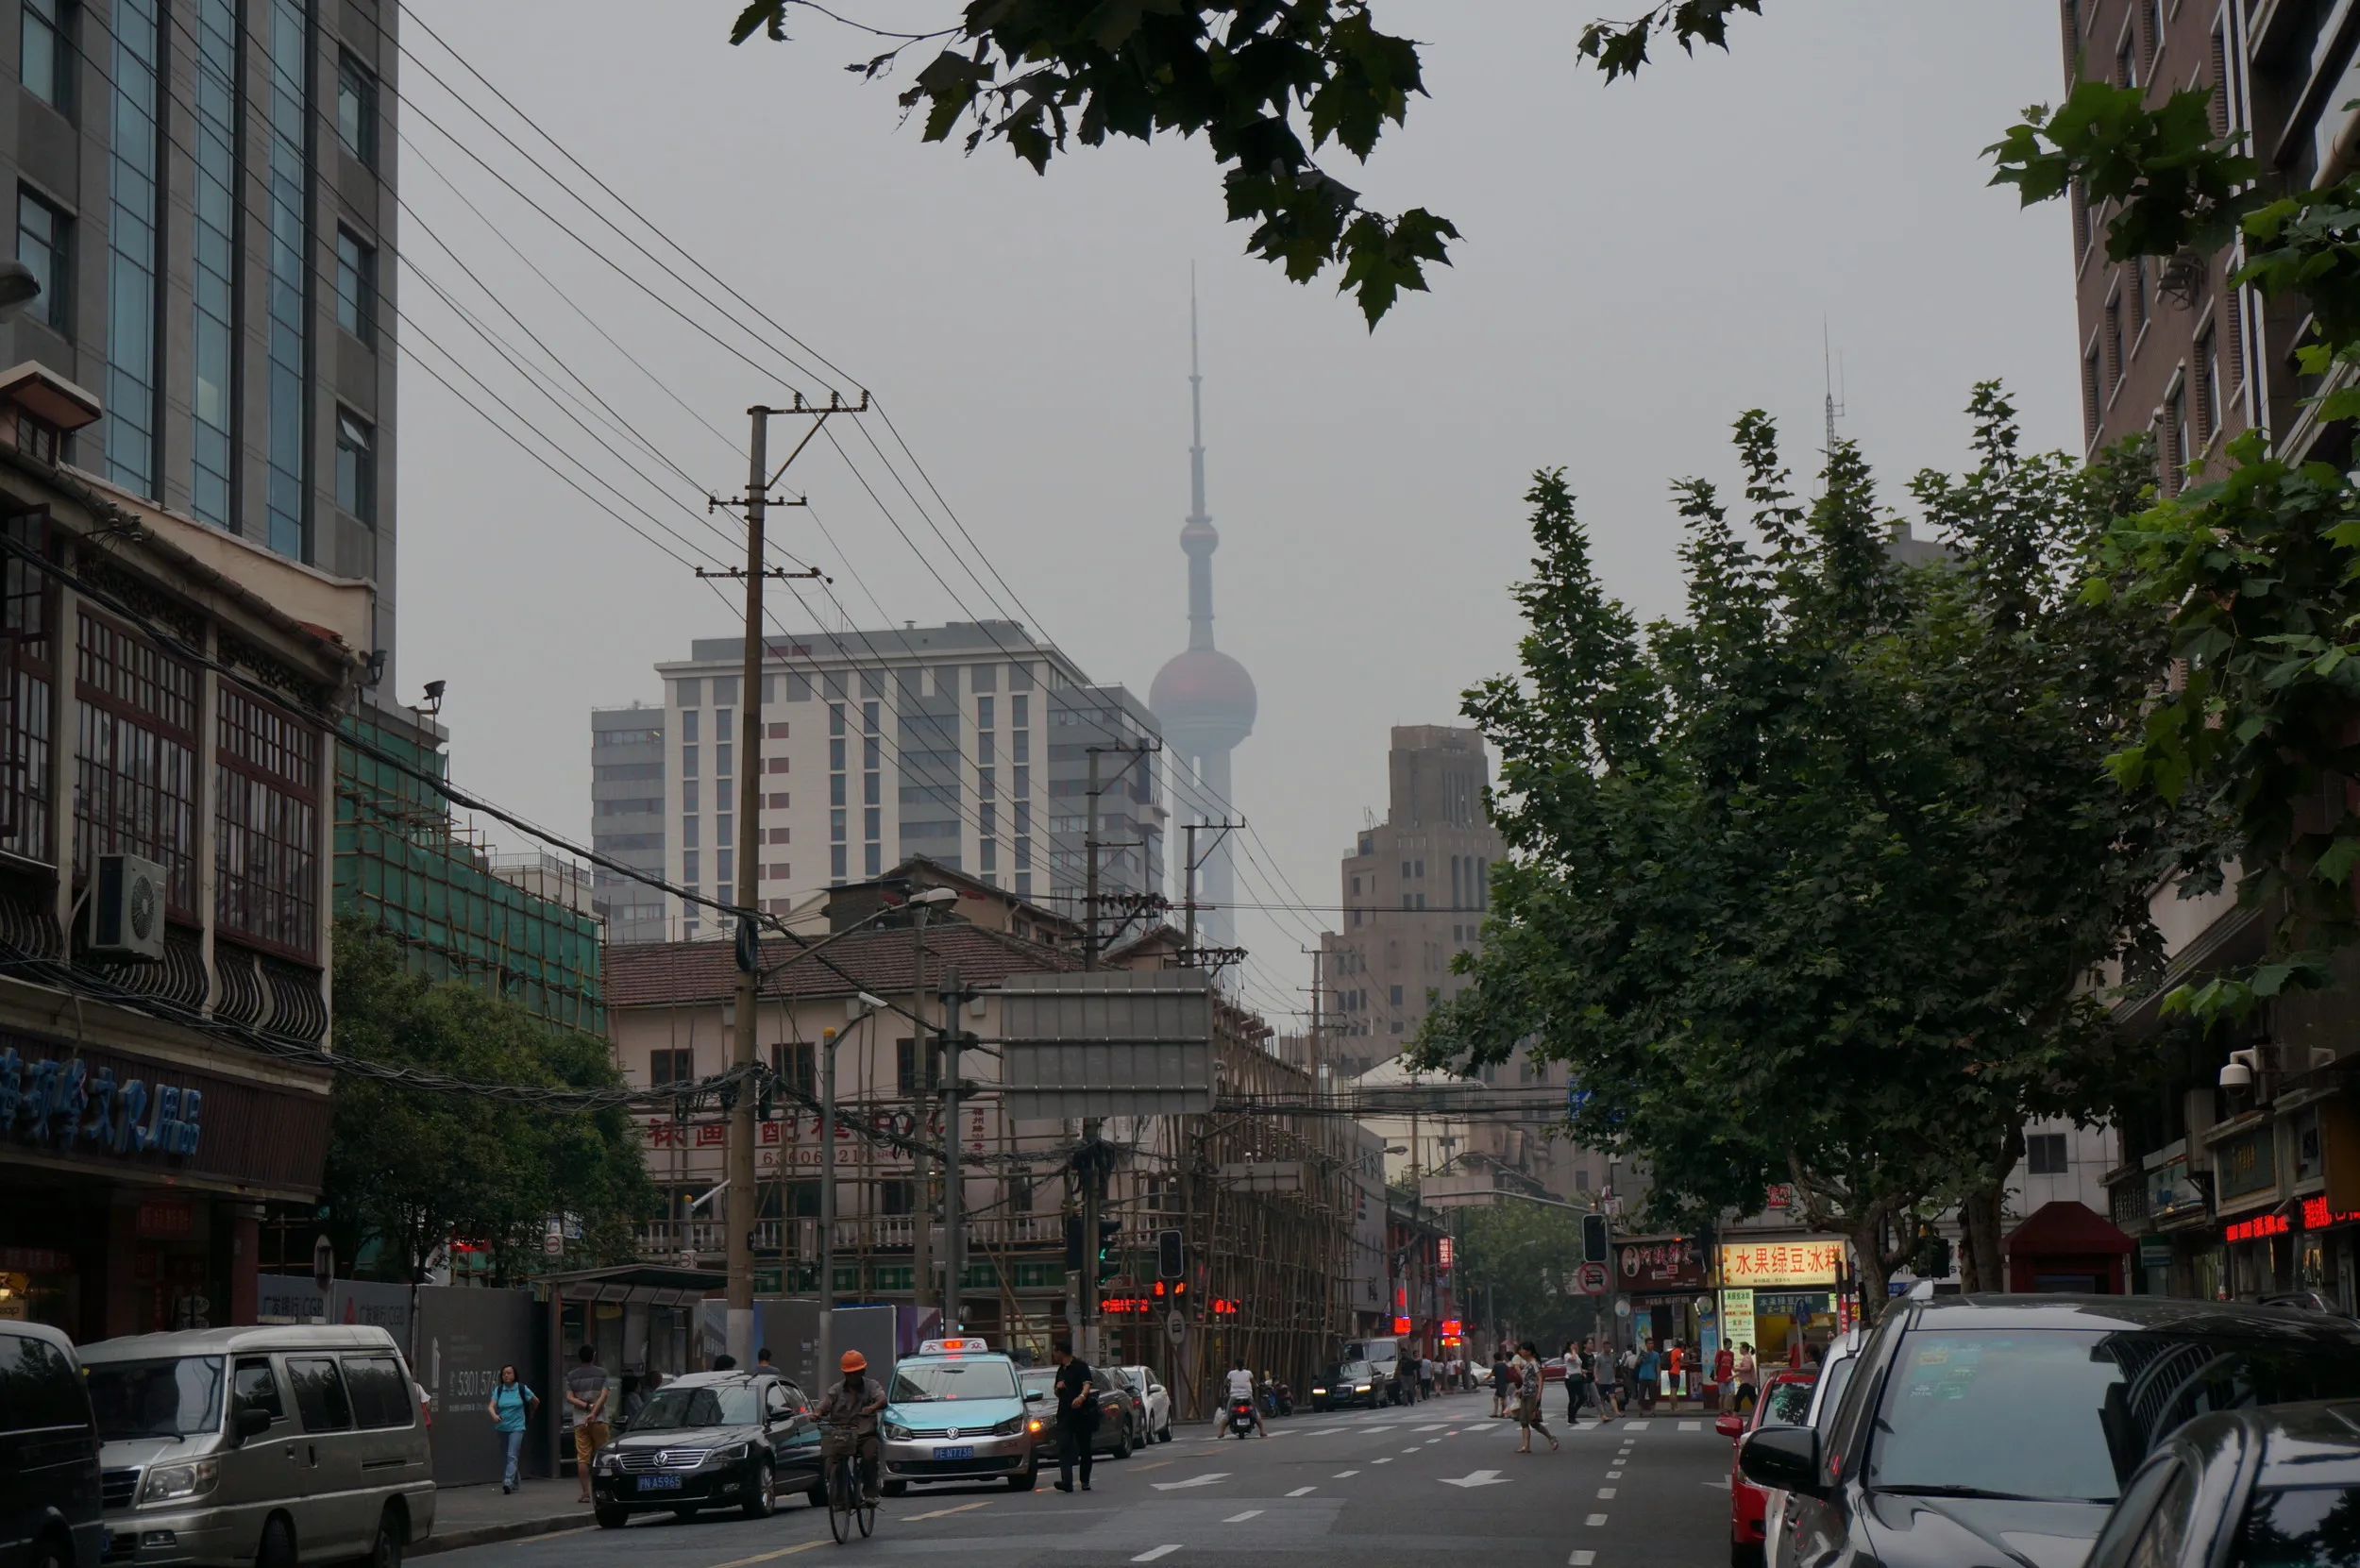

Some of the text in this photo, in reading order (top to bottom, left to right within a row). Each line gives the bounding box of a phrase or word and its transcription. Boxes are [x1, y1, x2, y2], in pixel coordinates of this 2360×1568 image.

[1735, 1245, 1841, 1274] 水果绿豆冰糕
[263, 1295, 325, 1317] 广发银行 CGB
[925, 1343, 937, 1352] 大
[970, 1341, 983, 1350] 众
[458, 1371, 479, 1396] 5301
